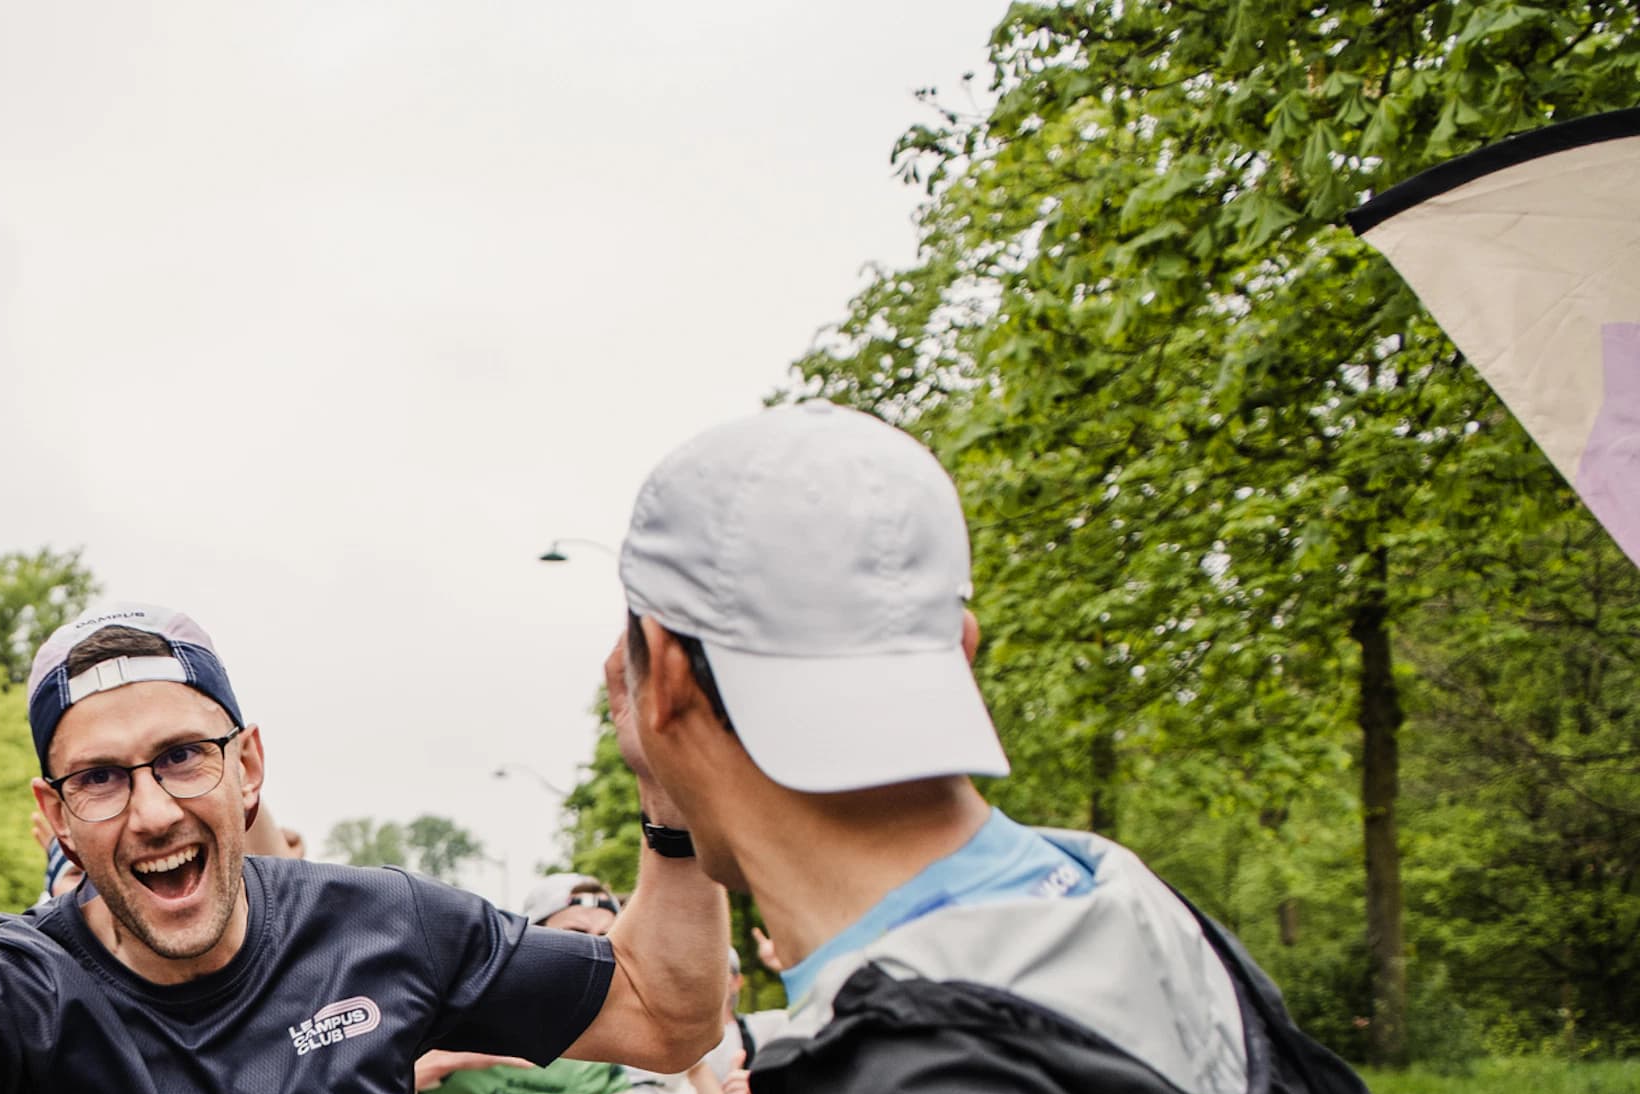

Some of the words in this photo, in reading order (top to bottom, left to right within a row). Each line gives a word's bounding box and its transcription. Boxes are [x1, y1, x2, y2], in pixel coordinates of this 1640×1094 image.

[288, 1019, 313, 1039] LE
[293, 1010, 366, 1048] CAMPUS
[297, 1028, 344, 1056] CLUB
